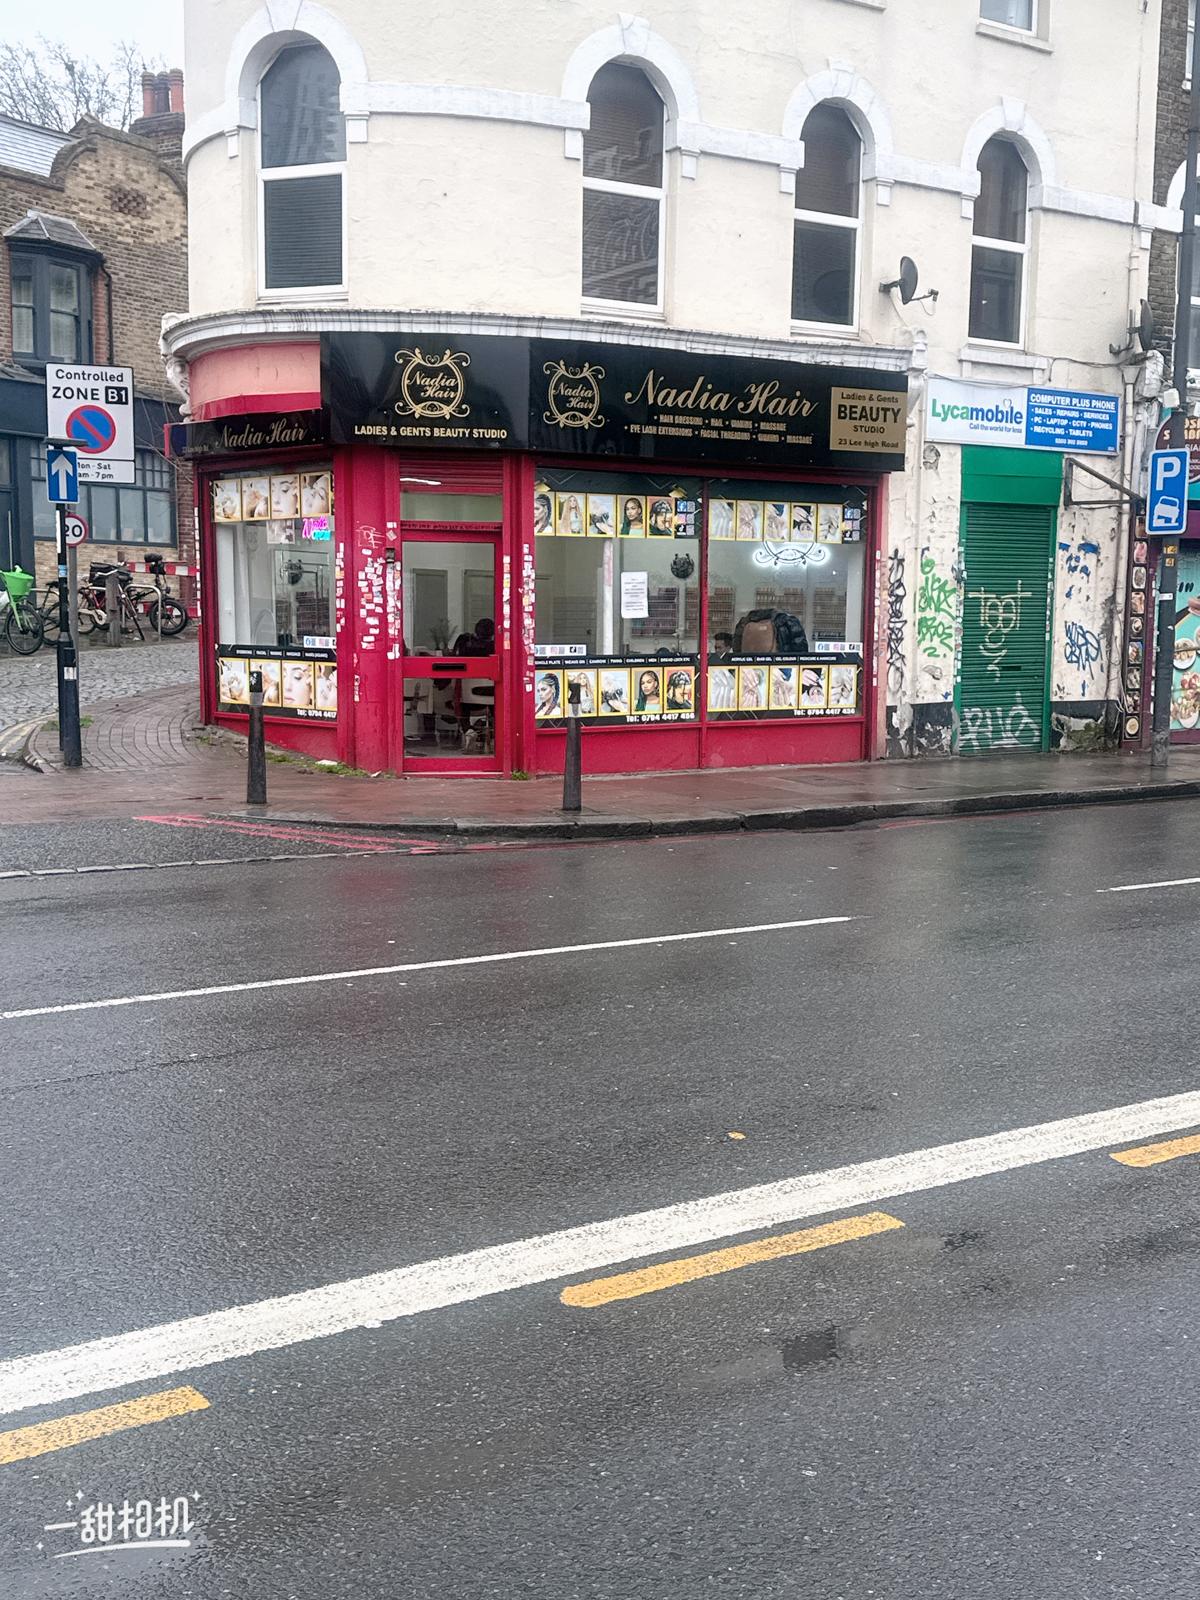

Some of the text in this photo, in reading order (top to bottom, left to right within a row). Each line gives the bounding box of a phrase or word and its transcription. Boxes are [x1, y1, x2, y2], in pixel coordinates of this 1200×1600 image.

[56, 369, 123, 382] Controlled
[407, 371, 458, 386] Nadia
[52, 386, 127, 402] ZONE B1
[421, 384, 458, 398] Hair
[553, 382, 595, 397] Nadia
[625, 369, 819, 417] Nadia Hair
[566, 396, 594, 409] Hair
[841, 392, 898, 403] Ladies & Gents
[1030, 394, 1116, 410] COMPUTER PLUS PHONE
[837, 404, 901, 424] BEAUTY
[931, 398, 1023, 424] Lycamobile
[1034, 407, 1110, 420] SALES REPAIRS SERVICES
[853, 424, 886, 434] STUDIO
[1046, 418, 1068, 426] LAPTOP
[1090, 422, 1112, 430] PHONES
[215, 418, 307, 448] Nadia Hair
[354, 425, 507, 439] LADIES & GENTS BEAUTY STUDIO
[1034, 426, 1093, 437] RECYCLING TABLETS
[96, 462, 111, 470] Sat
[1156, 456, 1182, 491] P
